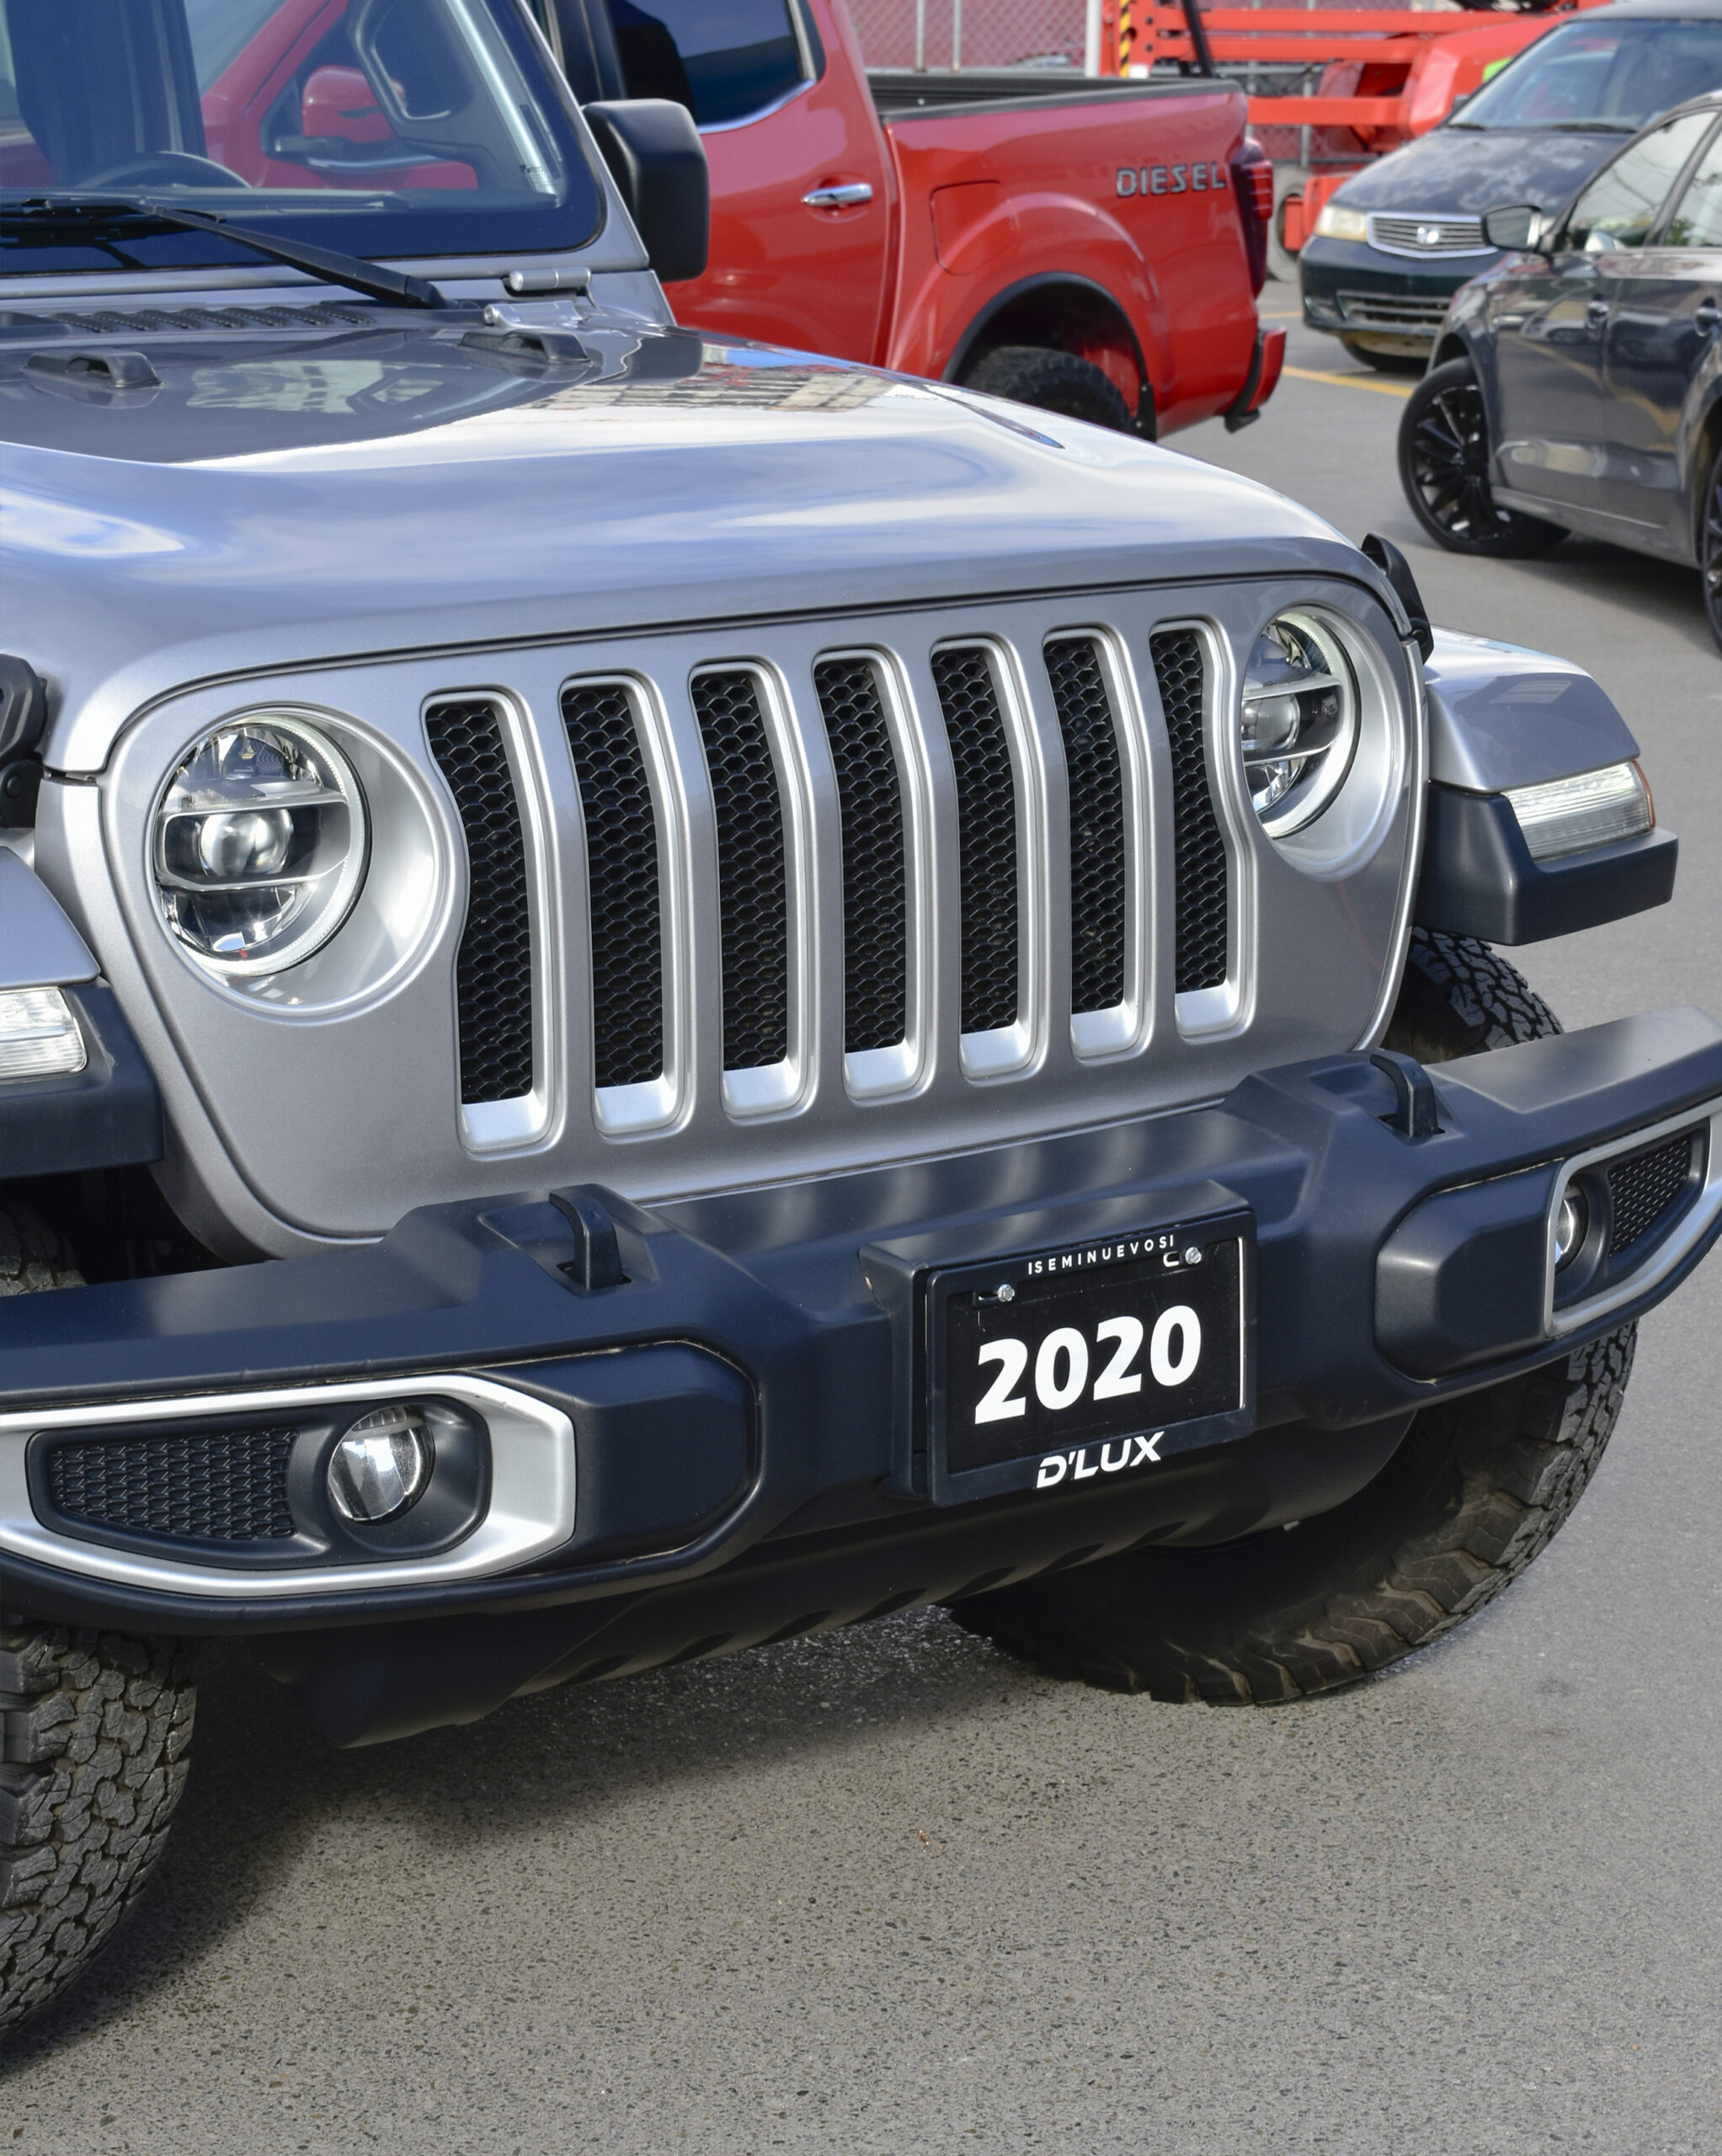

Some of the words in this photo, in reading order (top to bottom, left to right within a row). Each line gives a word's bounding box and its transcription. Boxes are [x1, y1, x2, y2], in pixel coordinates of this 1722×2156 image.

[1116, 161, 1226, 197] DIESEL
[974, 1305, 1202, 1425] 2020
[1036, 1431, 1165, 1489] D'LUX
